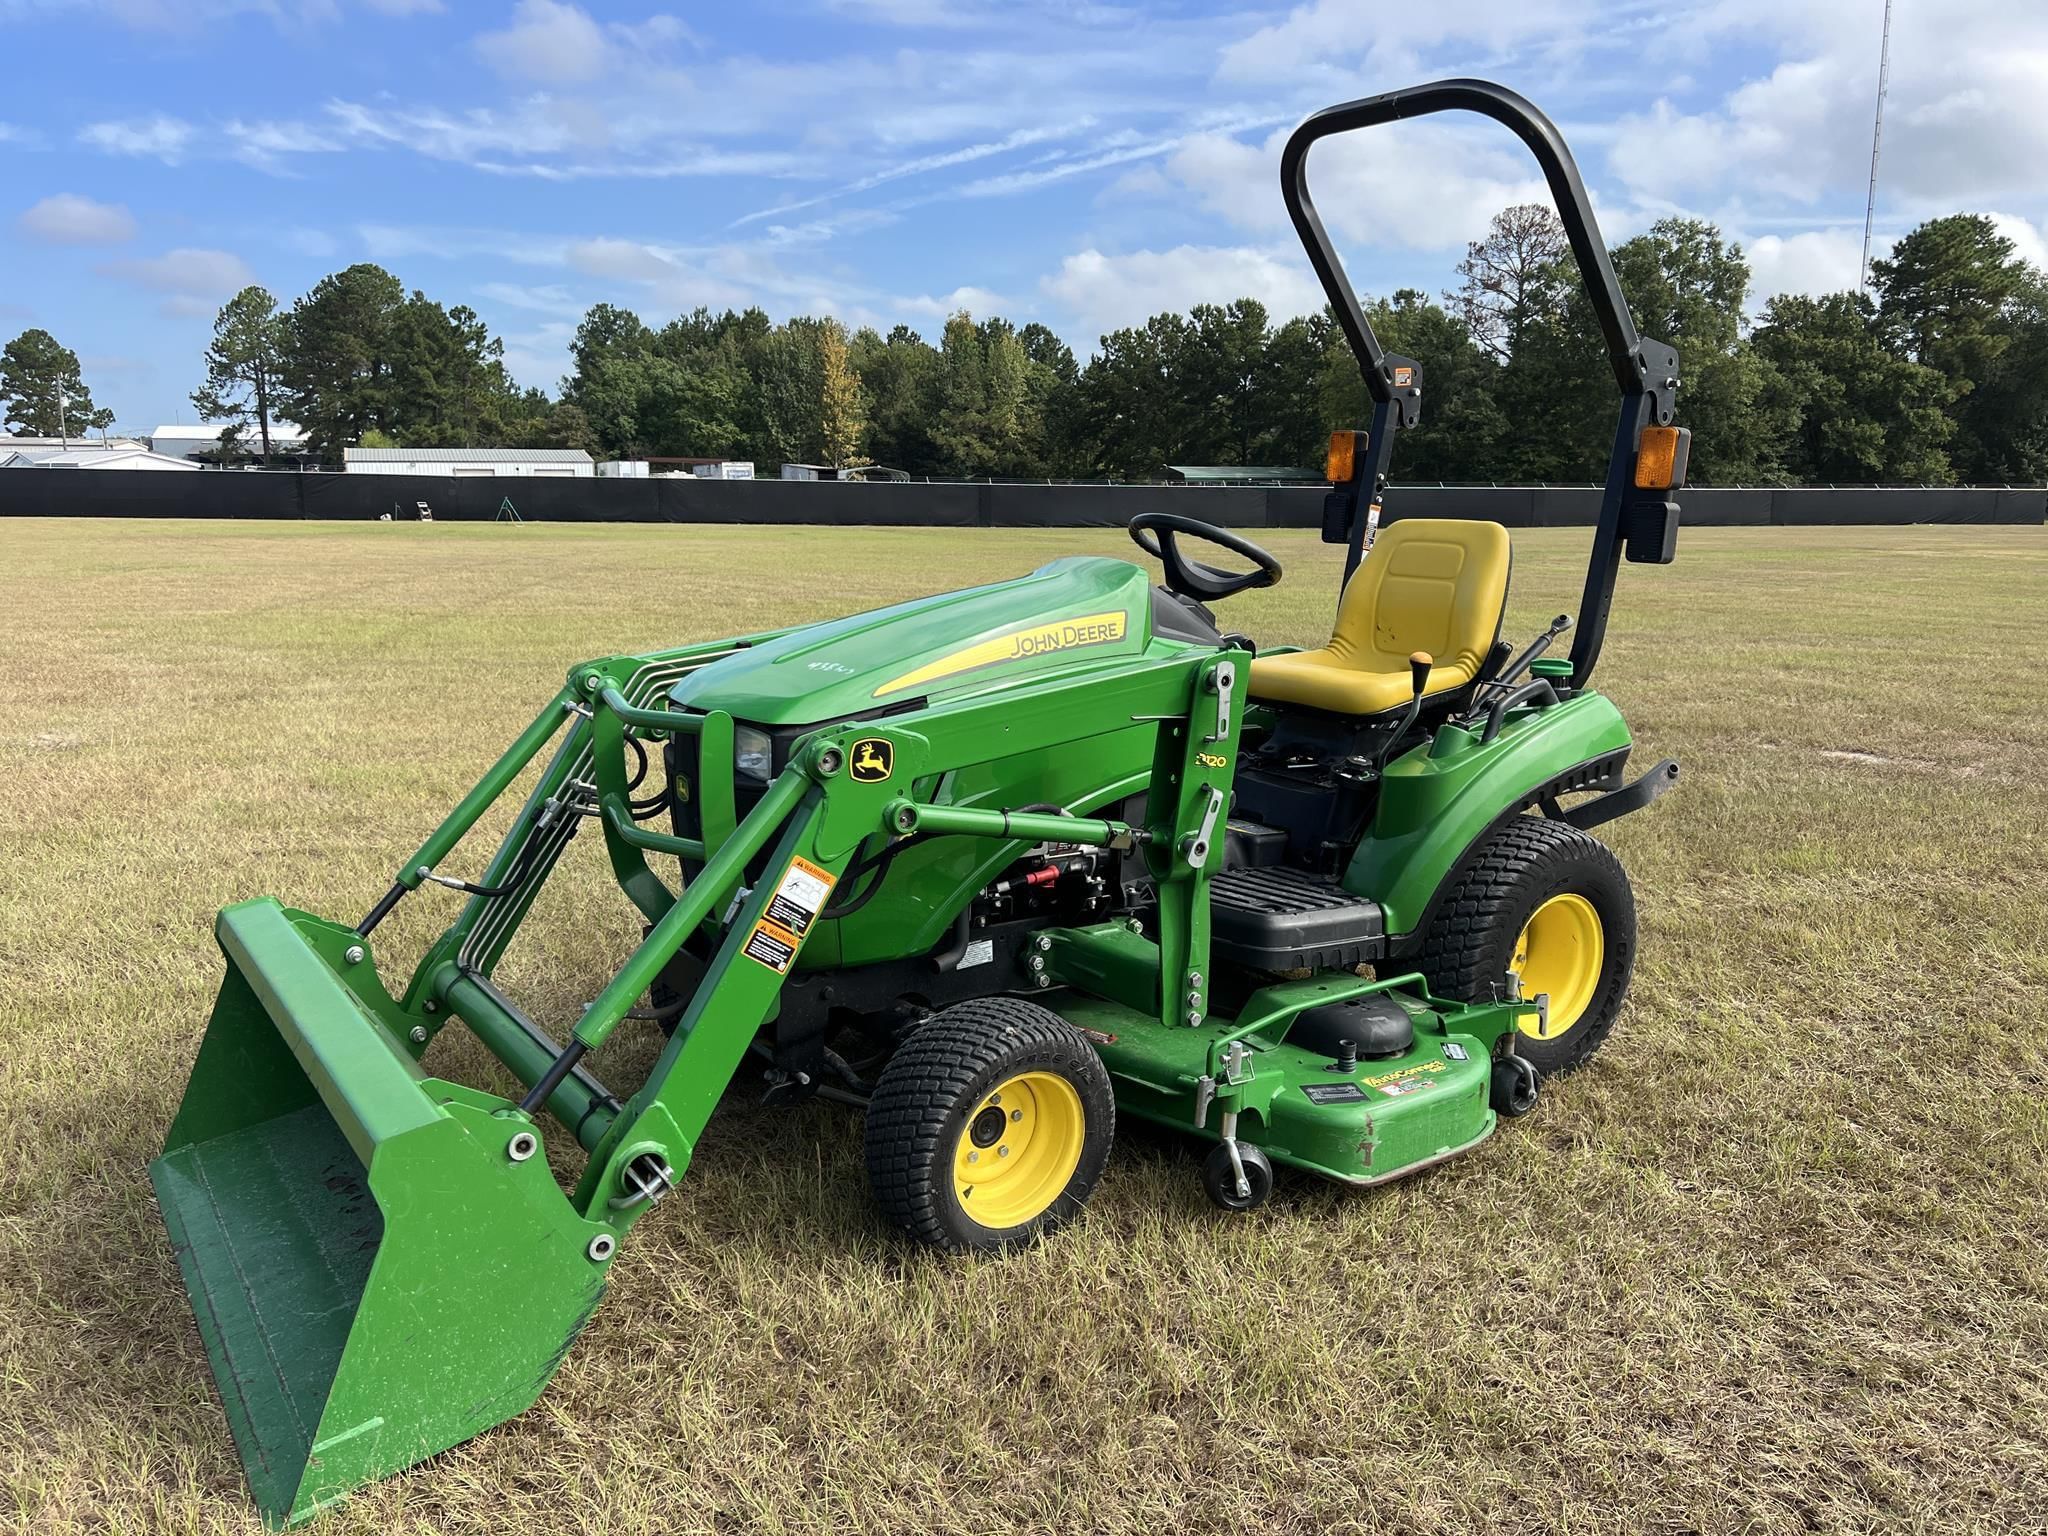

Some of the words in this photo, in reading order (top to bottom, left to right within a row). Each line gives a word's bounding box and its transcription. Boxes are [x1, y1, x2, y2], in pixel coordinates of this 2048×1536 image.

[1011, 632, 1060, 656] JOHN
[1063, 623, 1118, 644] DEERE
[804, 863, 831, 882] WARNING
[769, 928, 796, 946] WARNING
